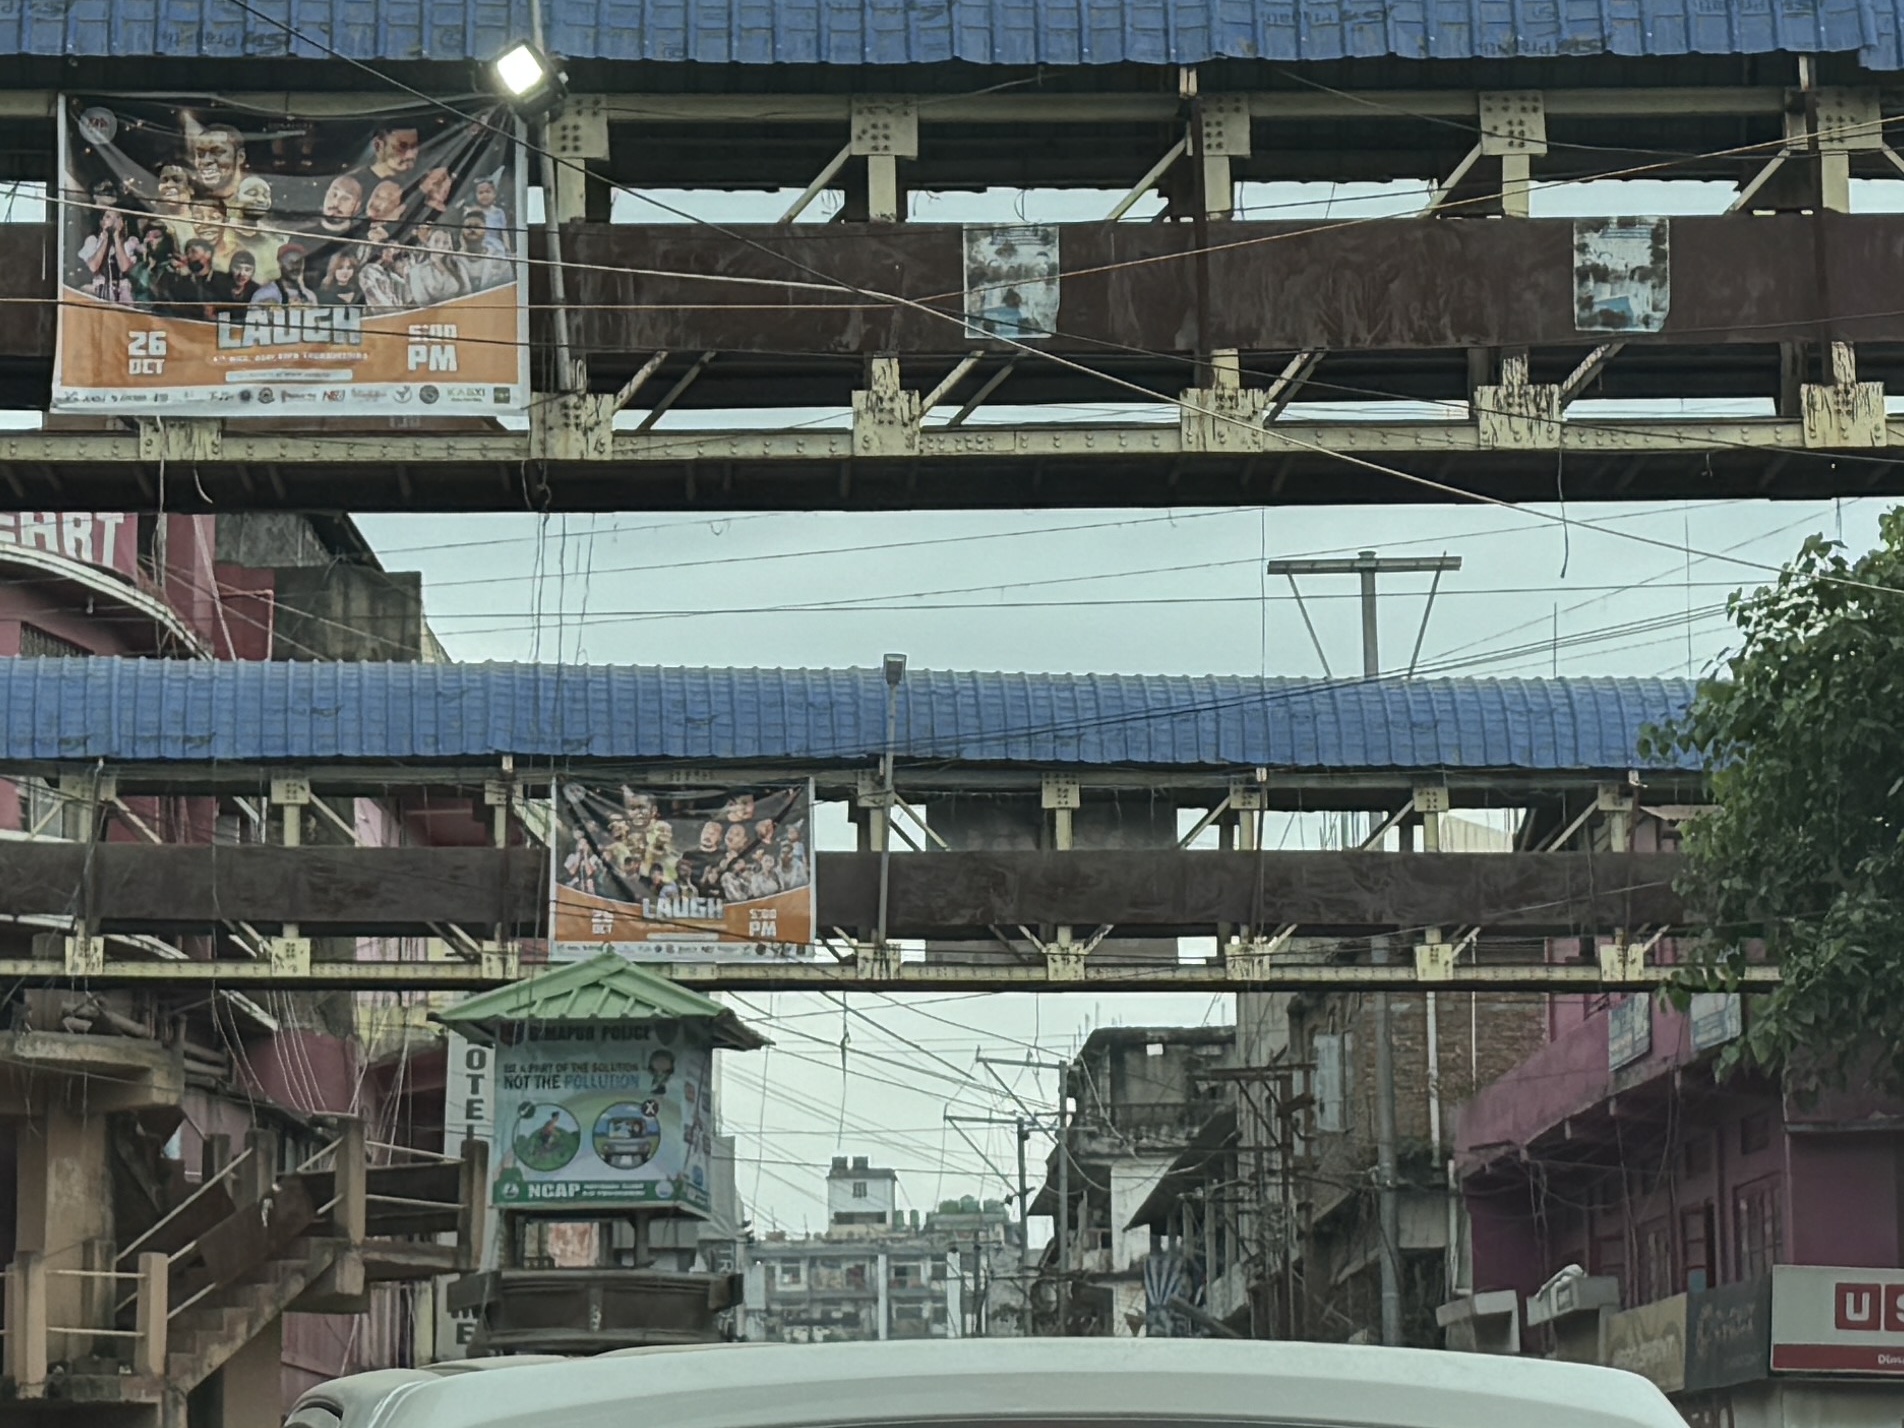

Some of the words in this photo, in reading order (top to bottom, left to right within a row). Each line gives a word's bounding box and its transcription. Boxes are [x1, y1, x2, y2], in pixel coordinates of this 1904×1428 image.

[217, 306, 362, 349] LAUGH
[127, 331, 167, 356] 26
[127, 358, 165, 375] OCT
[407, 344, 458, 372] PM
[642, 897, 724, 919] LAUGH
[749, 922, 777, 936] PM
[602, 1025, 650, 1041] POLICE
[503, 1074, 530, 1090] NOT
[533, 1074, 561, 1089] THE
[564, 1074, 639, 1089] POLLUTION
[528, 1183, 580, 1198] NCAP
